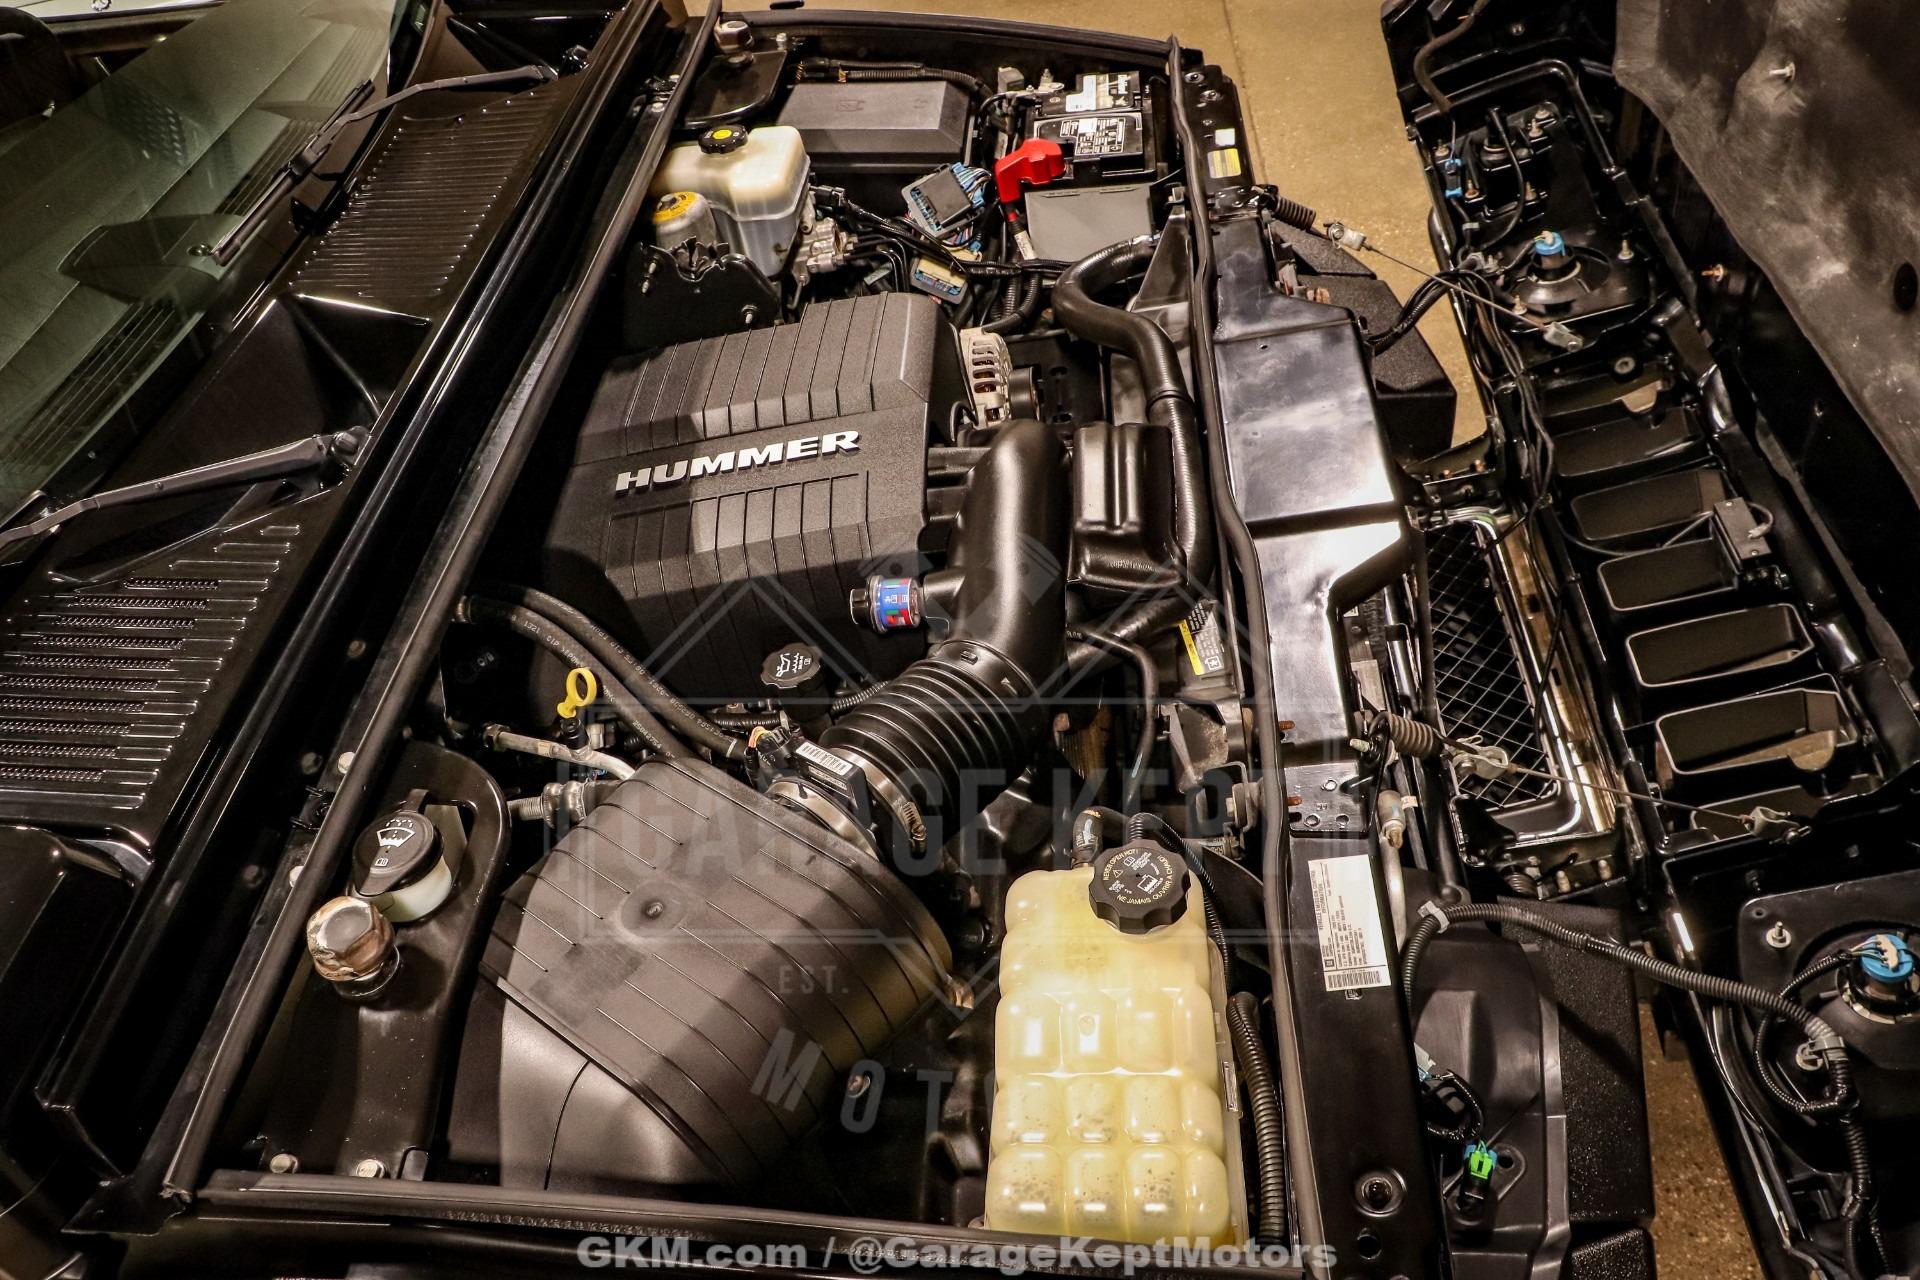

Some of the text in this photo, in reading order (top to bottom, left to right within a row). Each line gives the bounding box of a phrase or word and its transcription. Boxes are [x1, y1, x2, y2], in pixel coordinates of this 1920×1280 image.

[615, 430, 862, 494] HUMMER
[1110, 852, 1125, 866] OPEN
[1152, 880, 1173, 900] OUVRIR
